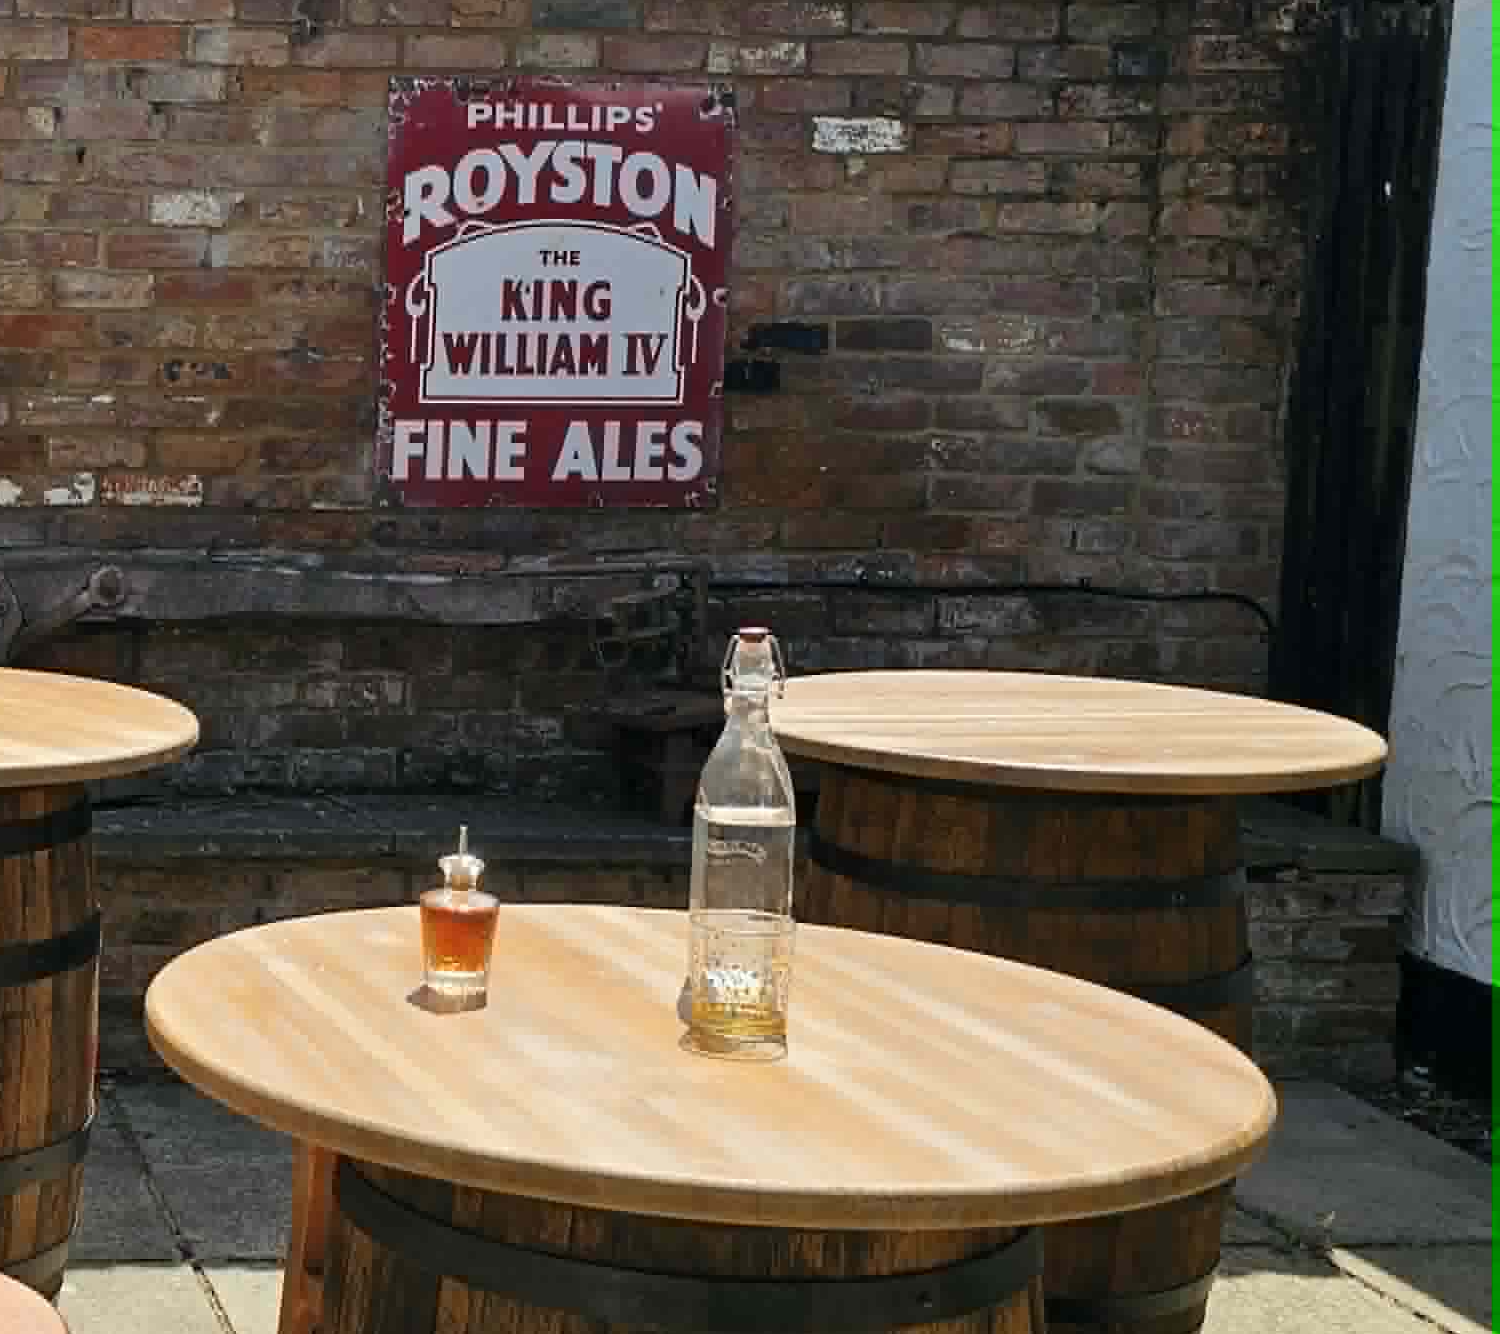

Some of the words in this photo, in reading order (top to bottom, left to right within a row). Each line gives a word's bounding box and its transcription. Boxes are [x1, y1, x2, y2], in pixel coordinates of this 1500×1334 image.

[403, 140, 717, 248] ROYSTON
[540, 250, 581, 267] THE
[501, 279, 612, 322] KING
[440, 332, 608, 377] WILLIAM
[621, 333, 668, 377] IV
[389, 419, 530, 481] FINE
[552, 419, 703, 481] ALES
